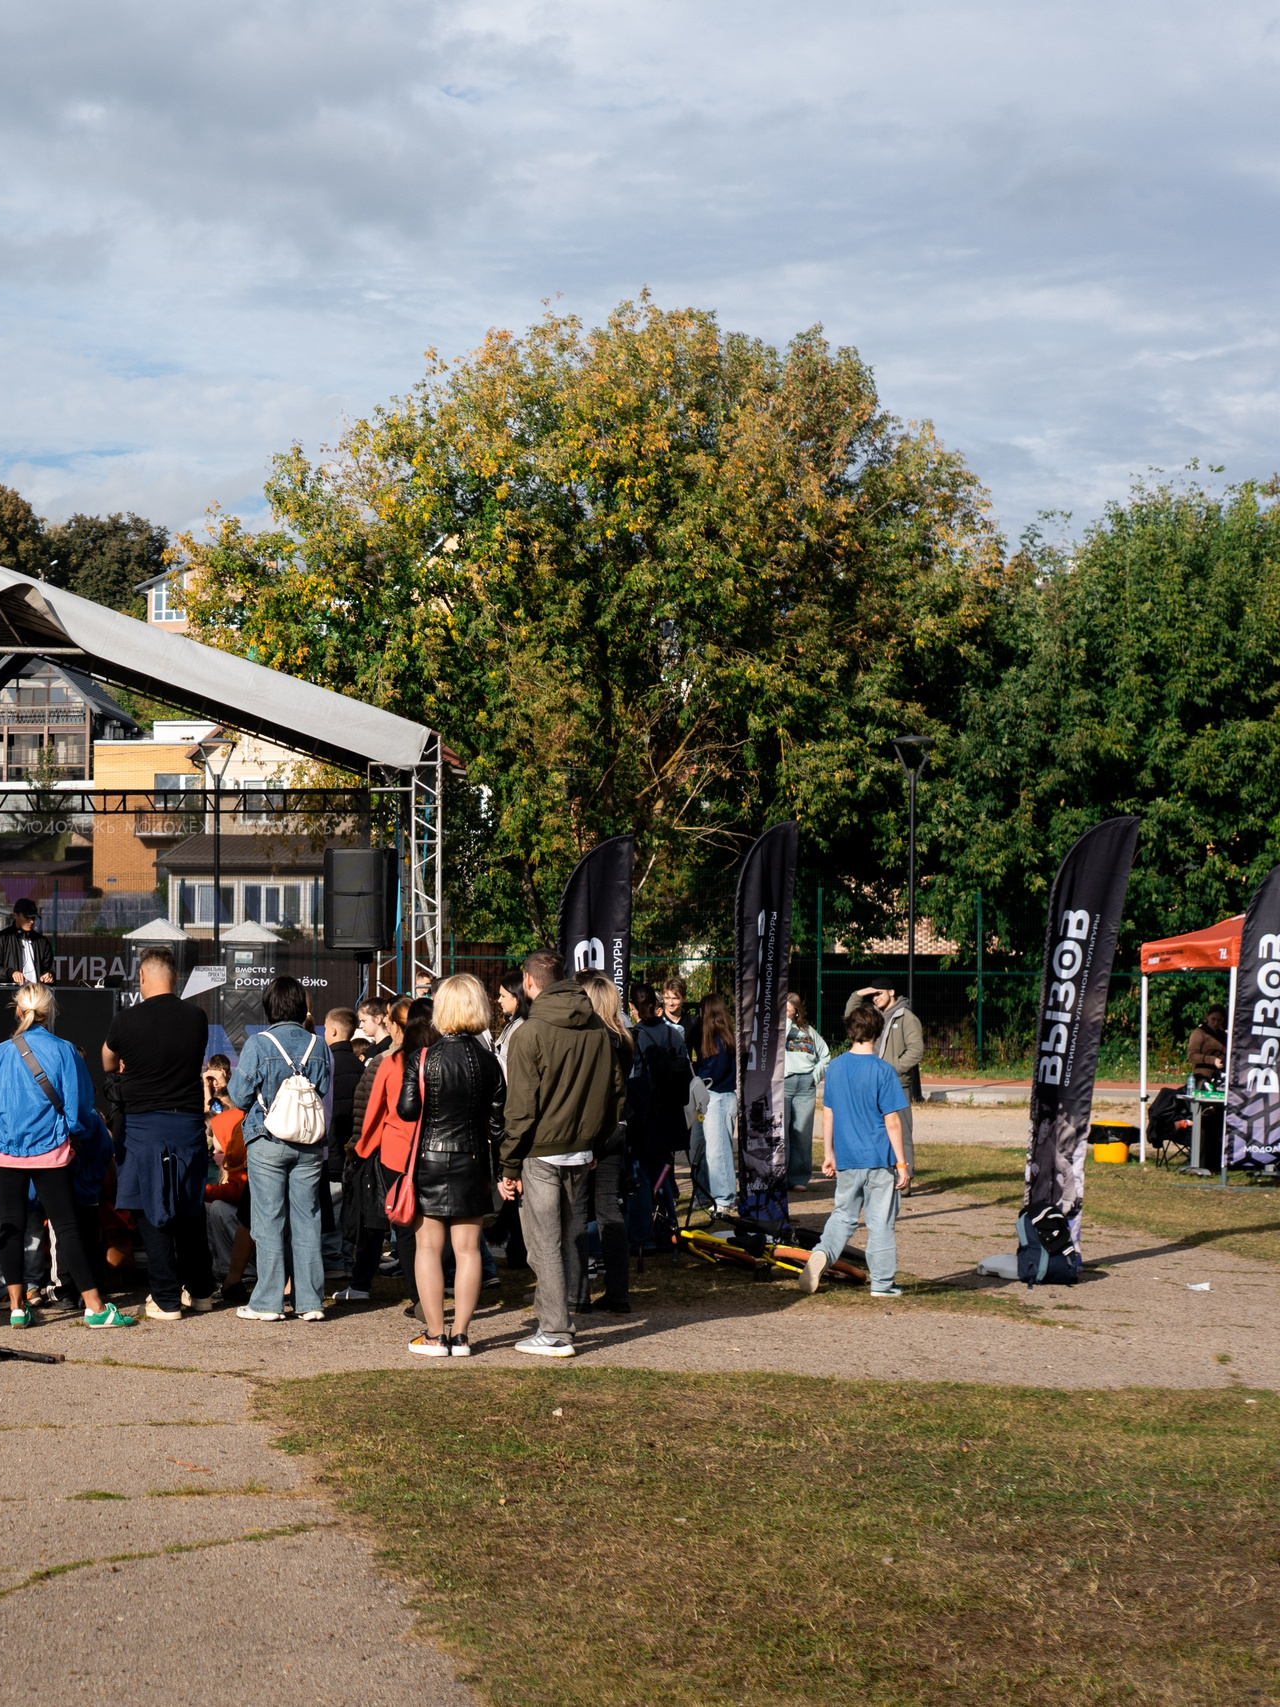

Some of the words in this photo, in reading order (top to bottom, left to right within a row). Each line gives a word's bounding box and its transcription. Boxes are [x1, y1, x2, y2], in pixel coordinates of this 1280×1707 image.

[767, 911, 778, 961] КУЛЬТУРЫ
[235, 966, 267, 974] вместе
[764, 962, 773, 1011] УЛИЧНОЙ
[1074, 970, 1090, 1023] УЛИЧНОЙ
[1085, 913, 1101, 967] КУЛЬТУРЫ
[1037, 909, 1091, 1086] ВЫЗОВ
